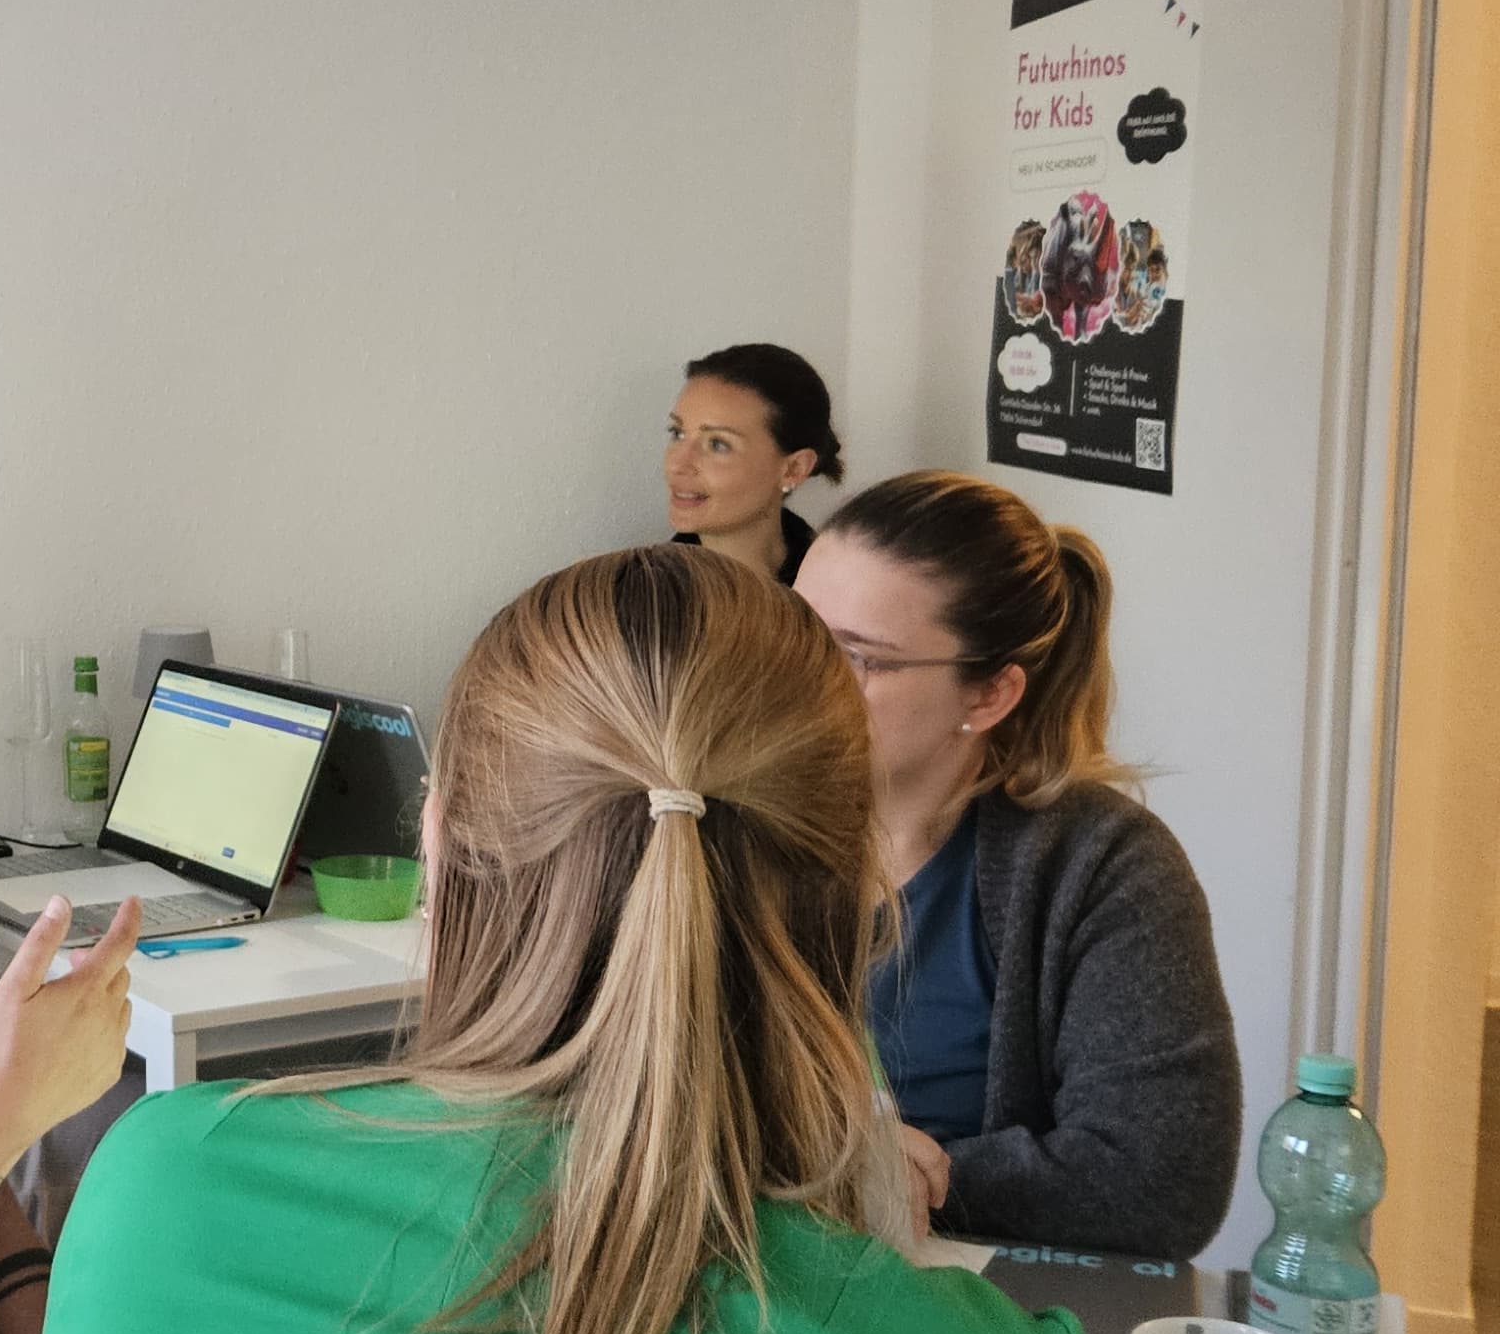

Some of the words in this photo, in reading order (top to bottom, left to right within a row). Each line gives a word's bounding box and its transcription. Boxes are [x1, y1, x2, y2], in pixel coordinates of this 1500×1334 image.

[1017, 43, 1126, 85] Futurhinos
[1014, 96, 1041, 129] for
[1049, 91, 1093, 128] Kids
